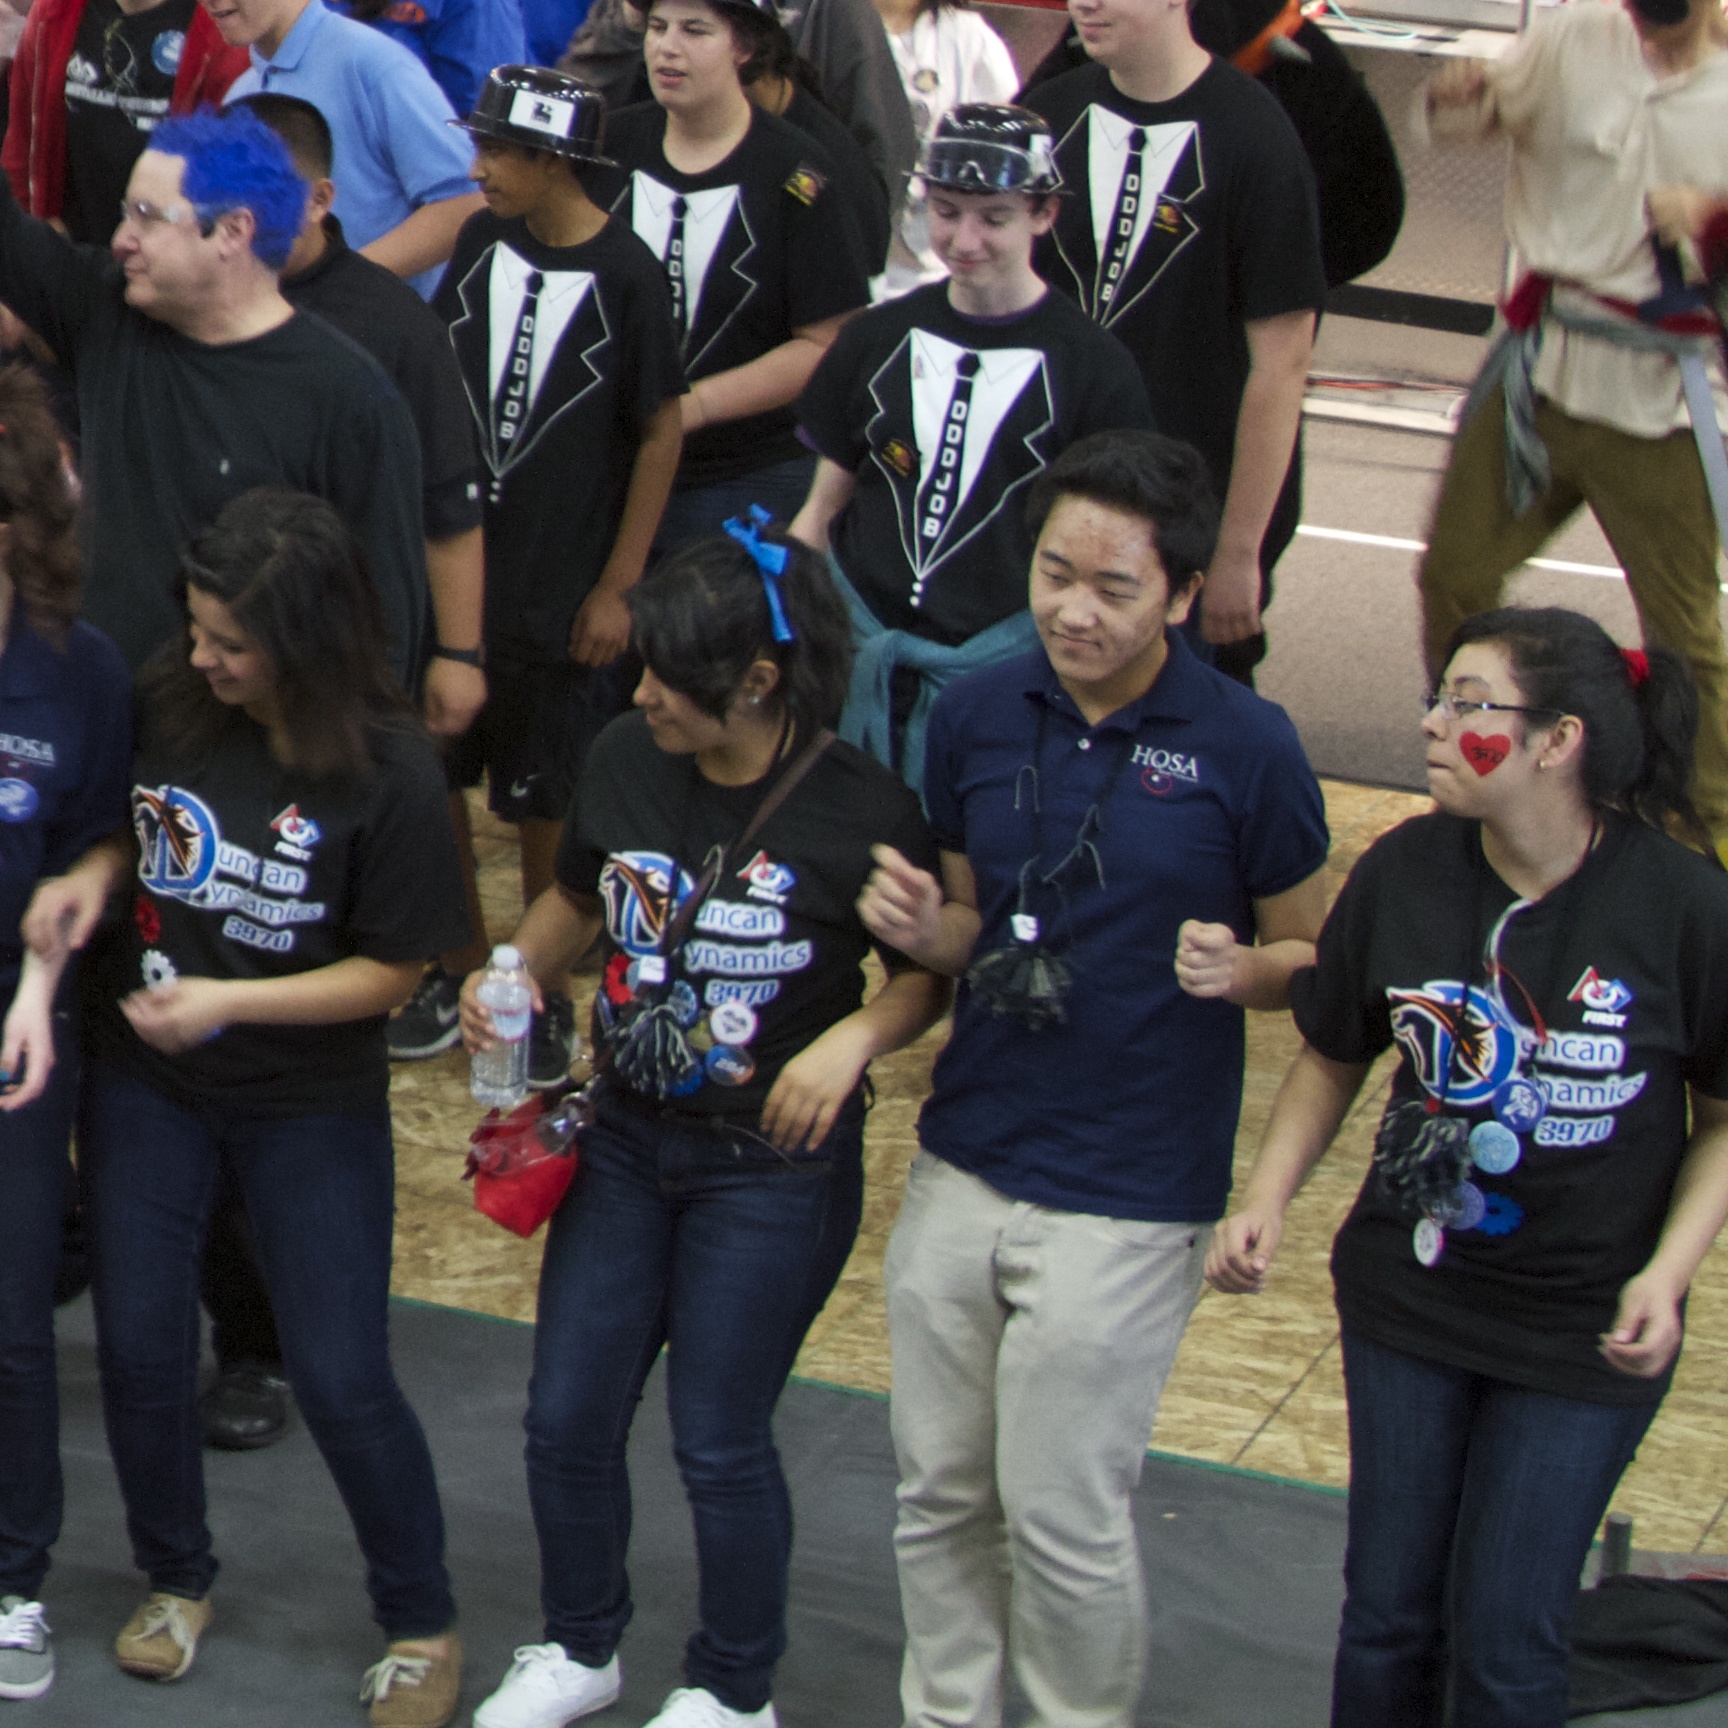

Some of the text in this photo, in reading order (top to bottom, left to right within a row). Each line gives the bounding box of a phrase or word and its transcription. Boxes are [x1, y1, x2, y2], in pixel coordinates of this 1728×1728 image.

[1130, 743, 1199, 778] HOSA
[224, 920, 292, 950] 3970
[709, 981, 777, 1004] 3970
[1581, 1010, 1629, 1028] FIRST
[1537, 1117, 1612, 1143] 3970
